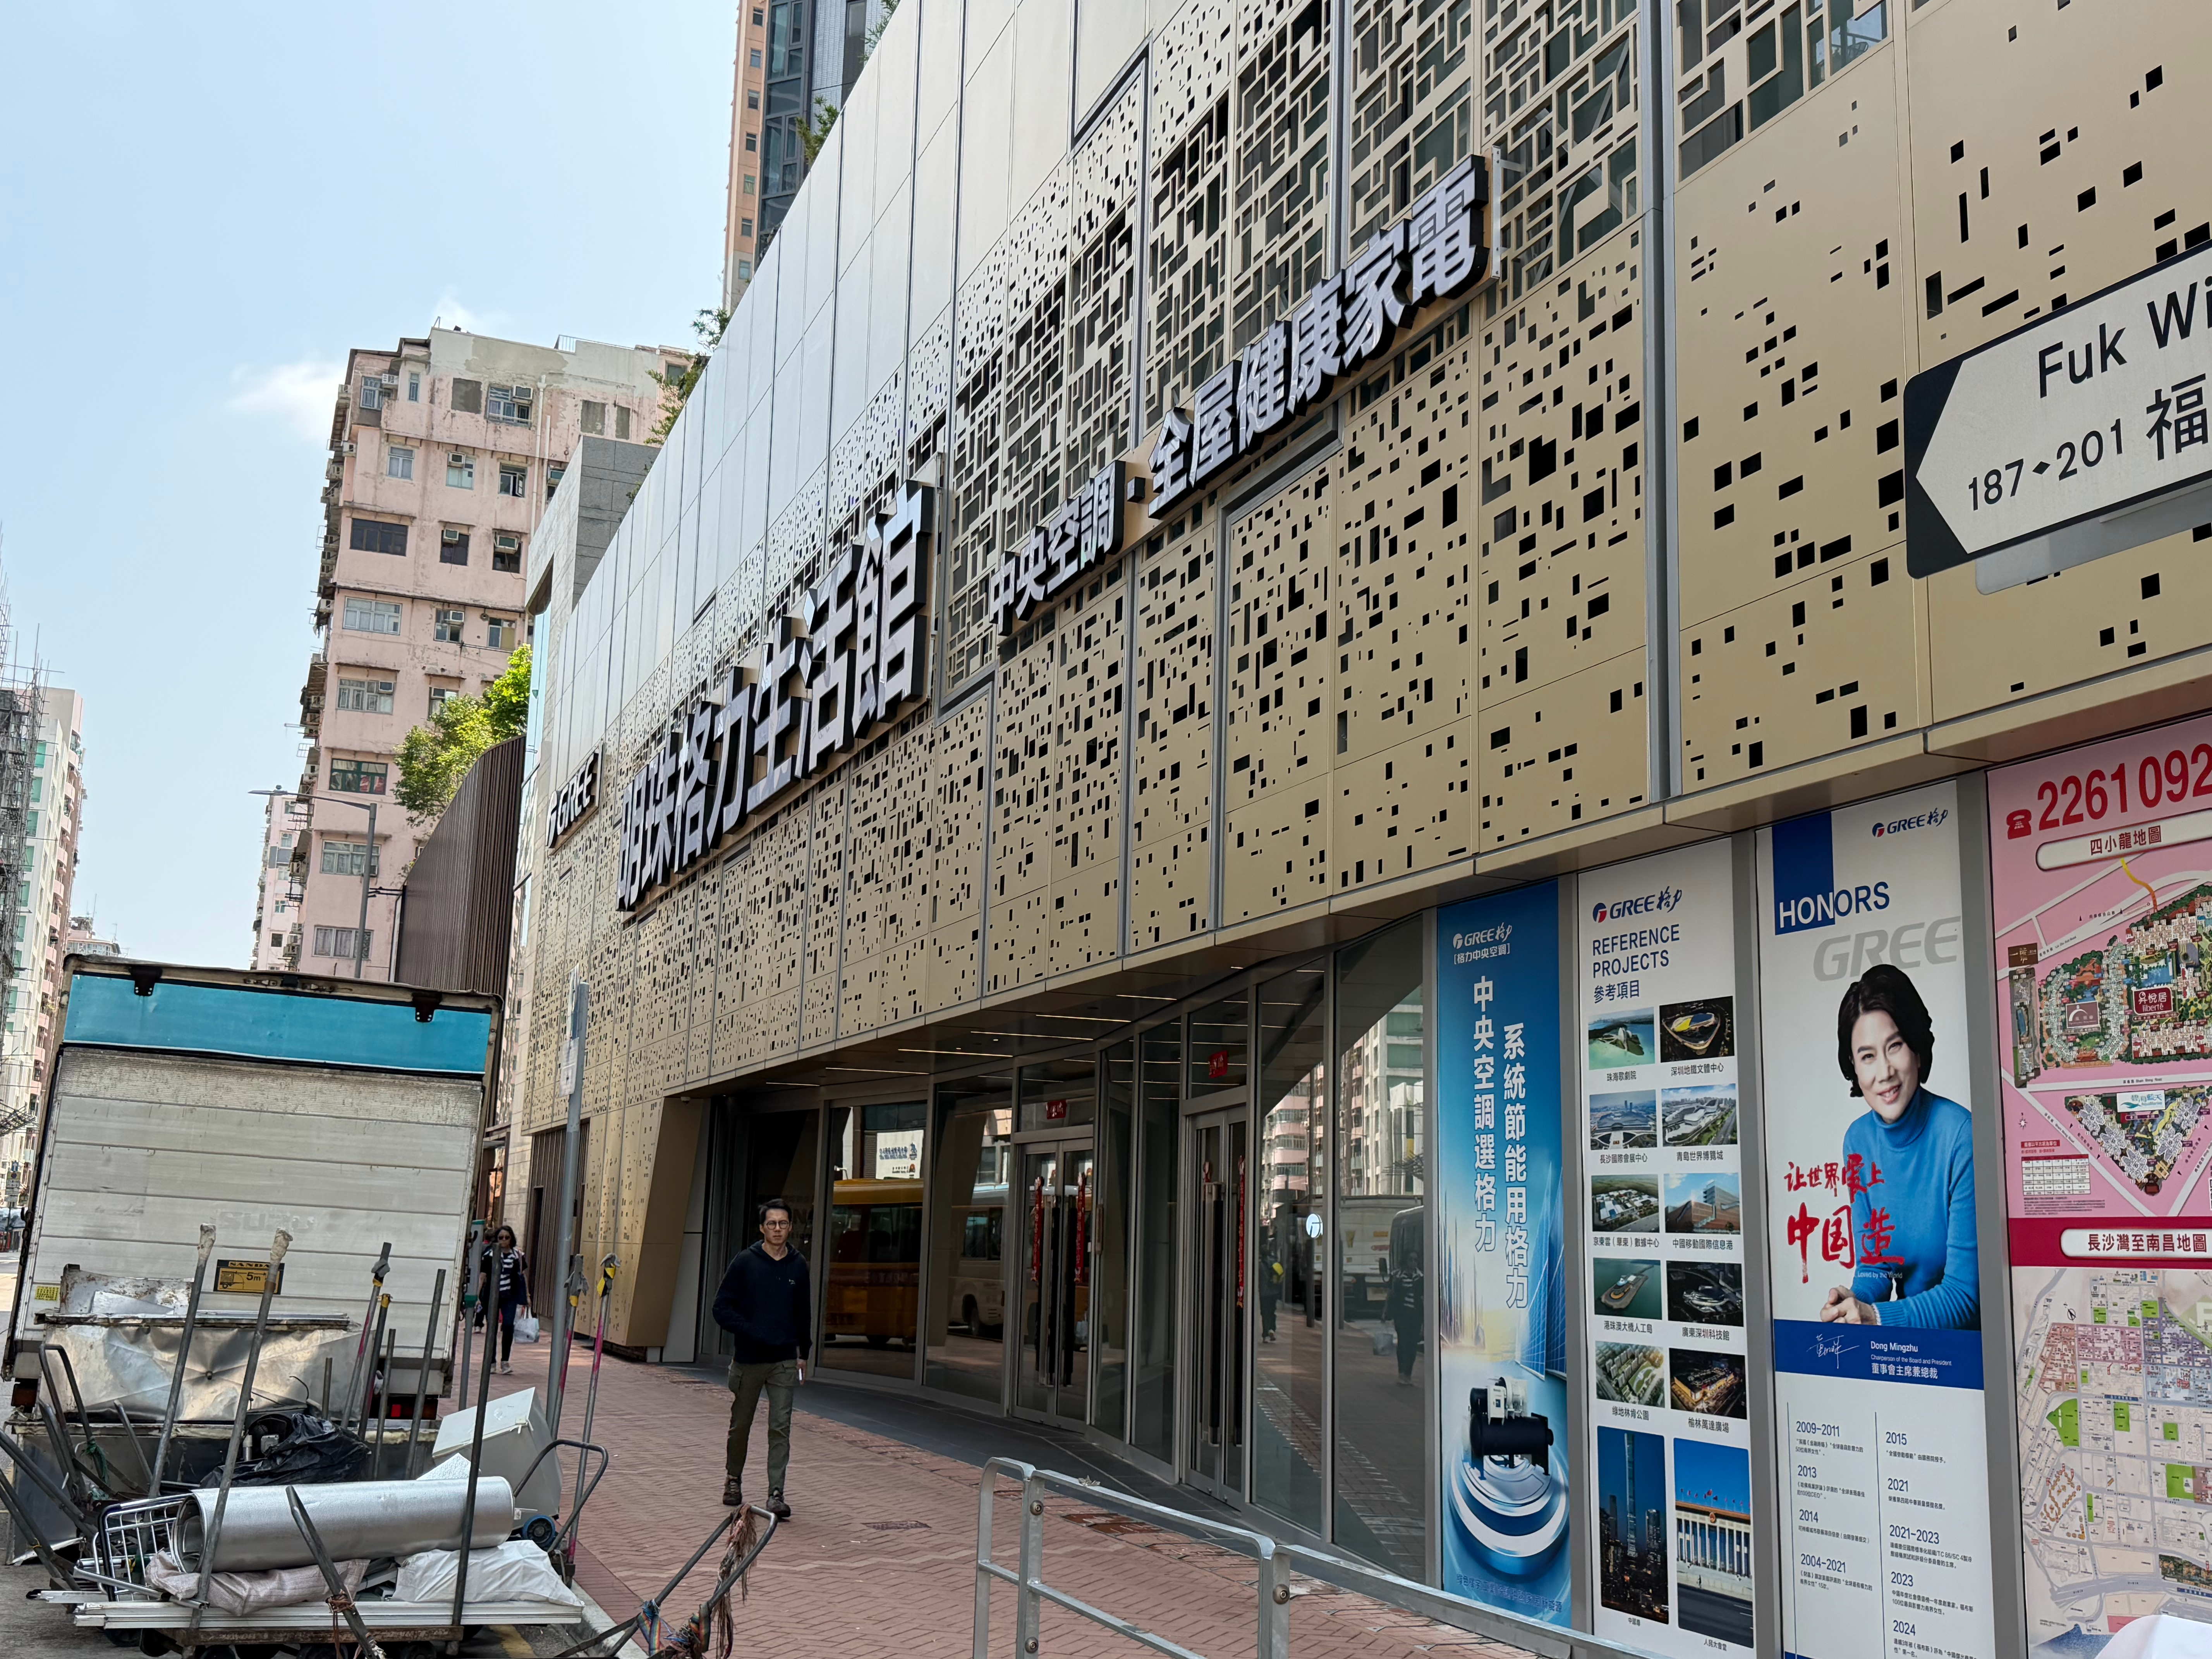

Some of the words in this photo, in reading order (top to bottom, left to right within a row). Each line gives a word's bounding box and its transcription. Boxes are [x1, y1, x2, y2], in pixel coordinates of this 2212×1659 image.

[2039, 323, 2127, 398] Fuk
[2146, 373, 2209, 461] 福
[617, 480, 934, 912] 明珠格力生活館
[1887, 814, 1926, 834] GREE
[2090, 825, 2162, 855] 四小龍地圖
[1610, 894, 1656, 919] GREE
[1779, 881, 1890, 928] HONORS
[1464, 928, 1495, 947] GREE
[1593, 924, 1680, 956] REFERENCE
[1814, 915, 1961, 982] GREE
[1593, 950, 1669, 978] PROJECTS
[1594, 980, 1640, 1003] 參考項目
[2142, 1003, 2164, 1012] liberté
[1607, 1071, 1637, 1082] 珠海歌劇院
[1474, 975, 1496, 1253] 中央空調選格力
[1676, 1150, 1723, 1162] 青島世界博覽城
[1504, 1022, 1529, 1309] 系統節能用格力
[1673, 1238, 1734, 1250] 中國移動國際信息港
[2088, 1233, 2207, 1253] 長沙灣至南昌地圖
[246, 1272, 261, 1281] 5m
[1604, 1320, 1652, 1334] 港珠澳大橋人工島
[1682, 1327, 1730, 1341] 廣東深圳科技館
[1870, 1341, 1888, 1352] Dong
[1889, 1342, 1918, 1353] Mingzhu
[1871, 1362, 1938, 1379] 董事會主席兼總裁
[1612, 1406, 1649, 1421] 綠地林肯公園
[1796, 1421, 1839, 1437] 2009-2011
[1886, 1431, 1907, 1445] 2015
[1797, 1465, 1817, 1478] 2013
[1887, 1478, 1908, 1492] 2021
[1799, 1509, 1819, 1523] 2014
[1889, 1524, 1939, 1544] 2021-2023
[1800, 1553, 1846, 1573] 2004-2021
[1891, 1571, 1913, 1587] 2023
[1893, 1620, 1916, 1636] 2024
